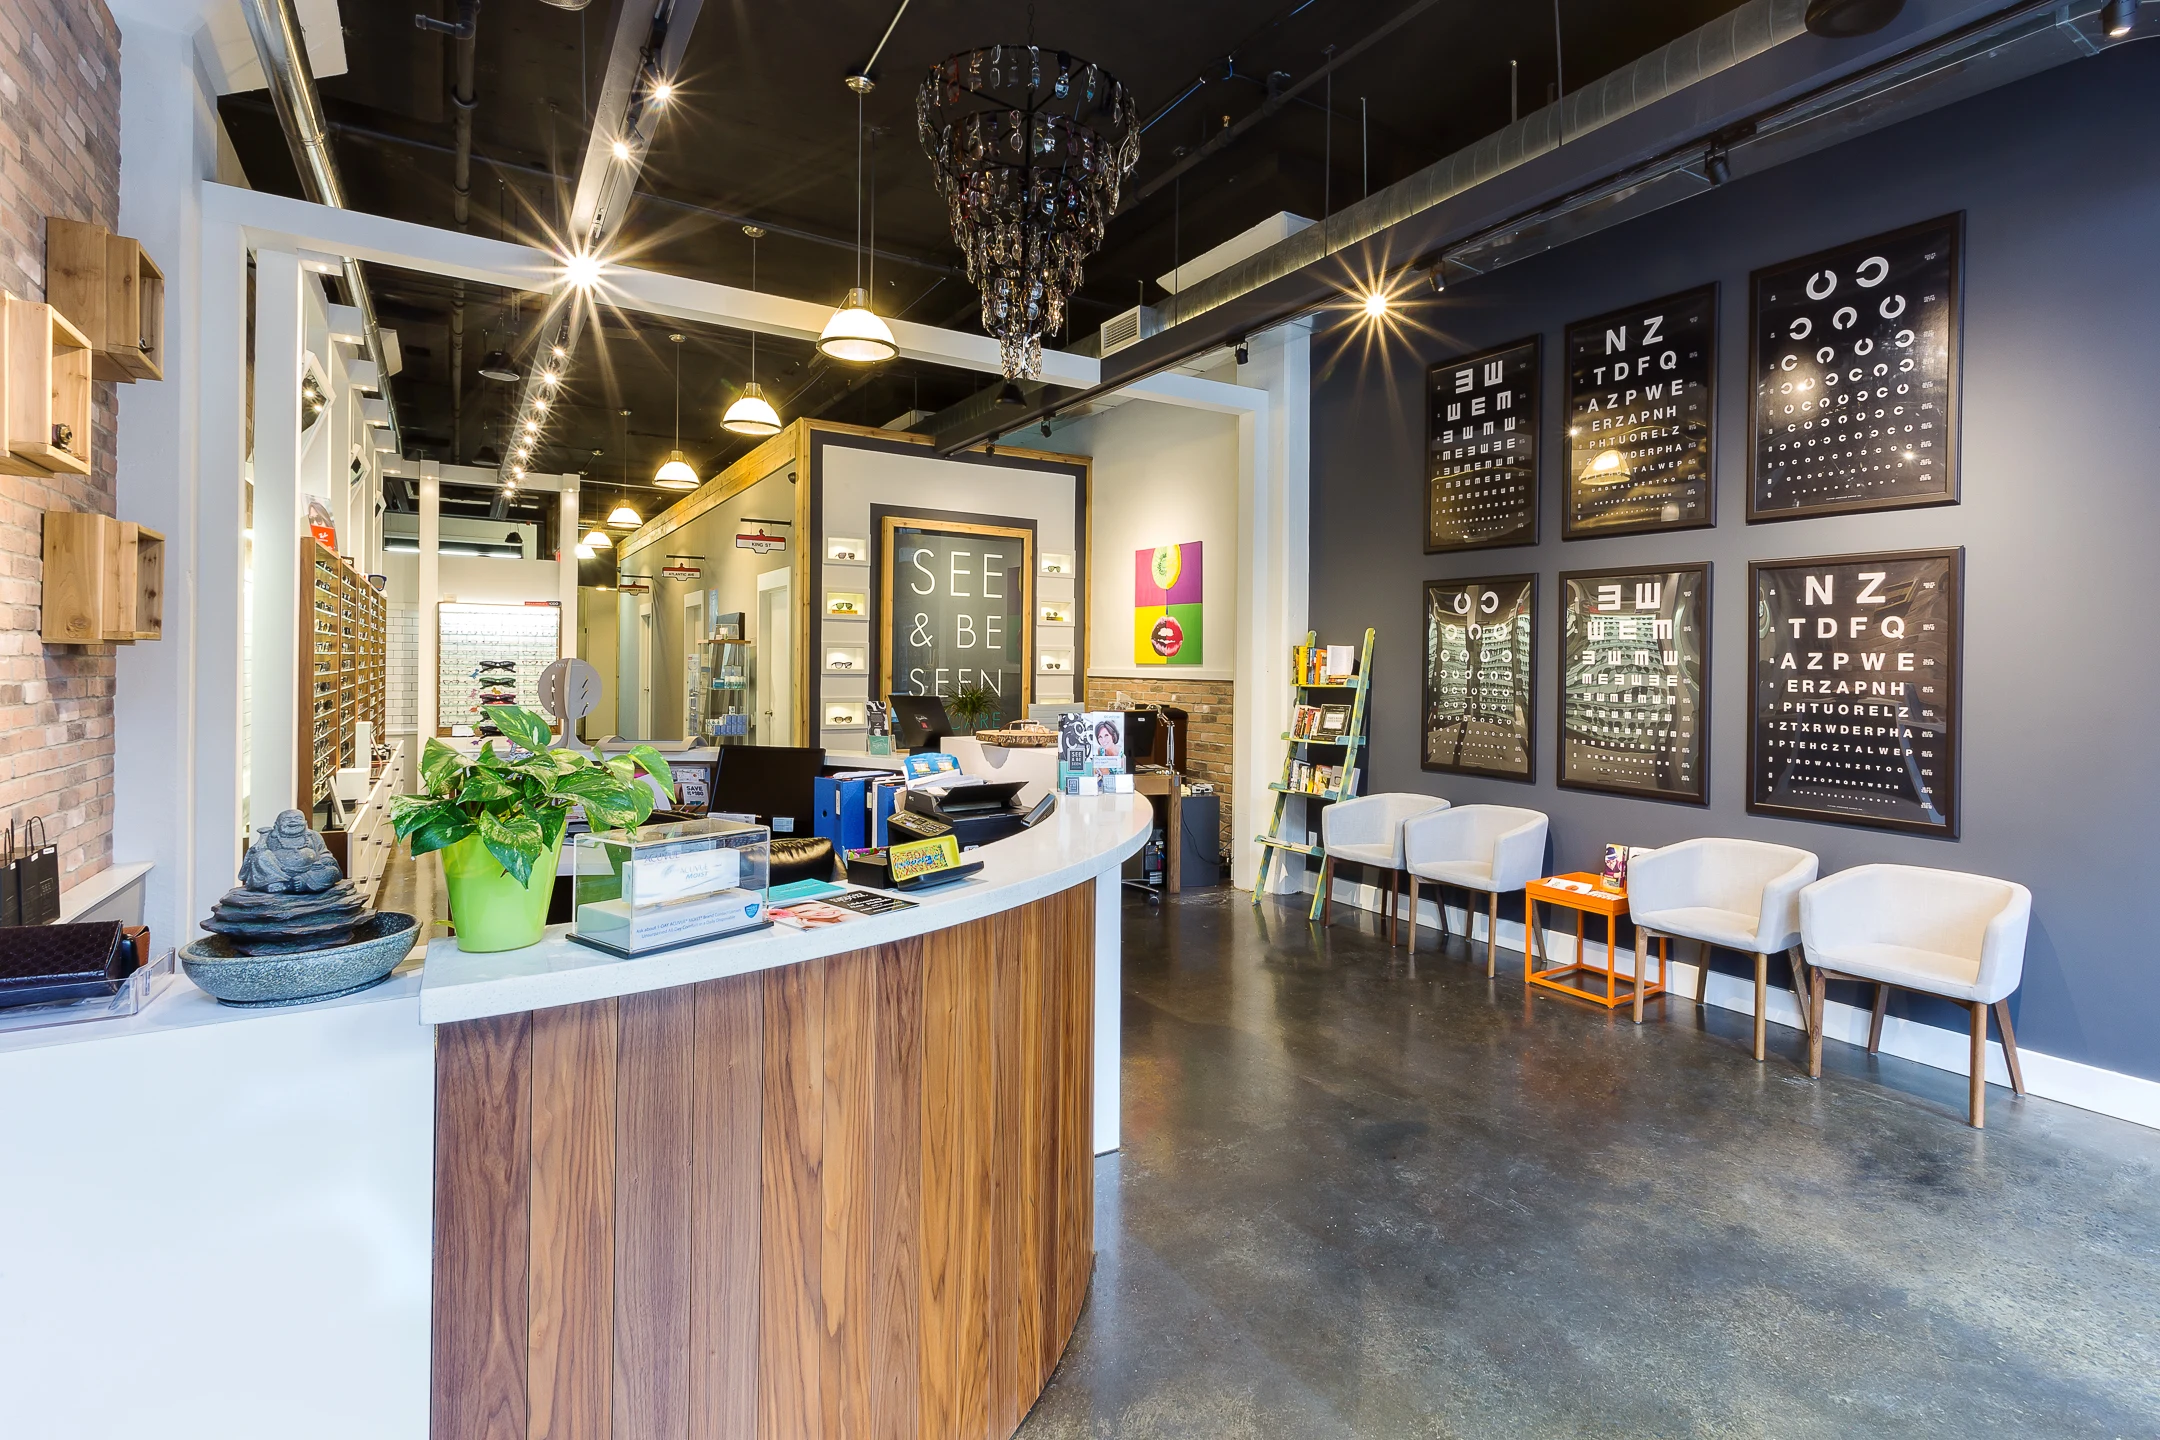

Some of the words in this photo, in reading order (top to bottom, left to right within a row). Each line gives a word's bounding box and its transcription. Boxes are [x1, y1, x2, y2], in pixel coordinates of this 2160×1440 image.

[1592, 405, 1676, 432] ERZAPNH
[910, 548, 1004, 599] SEE
[909, 612, 934, 648] &
[956, 613, 1002, 649] BE
[909, 668, 1002, 698] SEEN
[1787, 679, 1905, 696] ERZAPNH
[1783, 702, 1909, 718] PHTUORELZ
[1779, 721, 1913, 739] ZTXRWDERPHA
